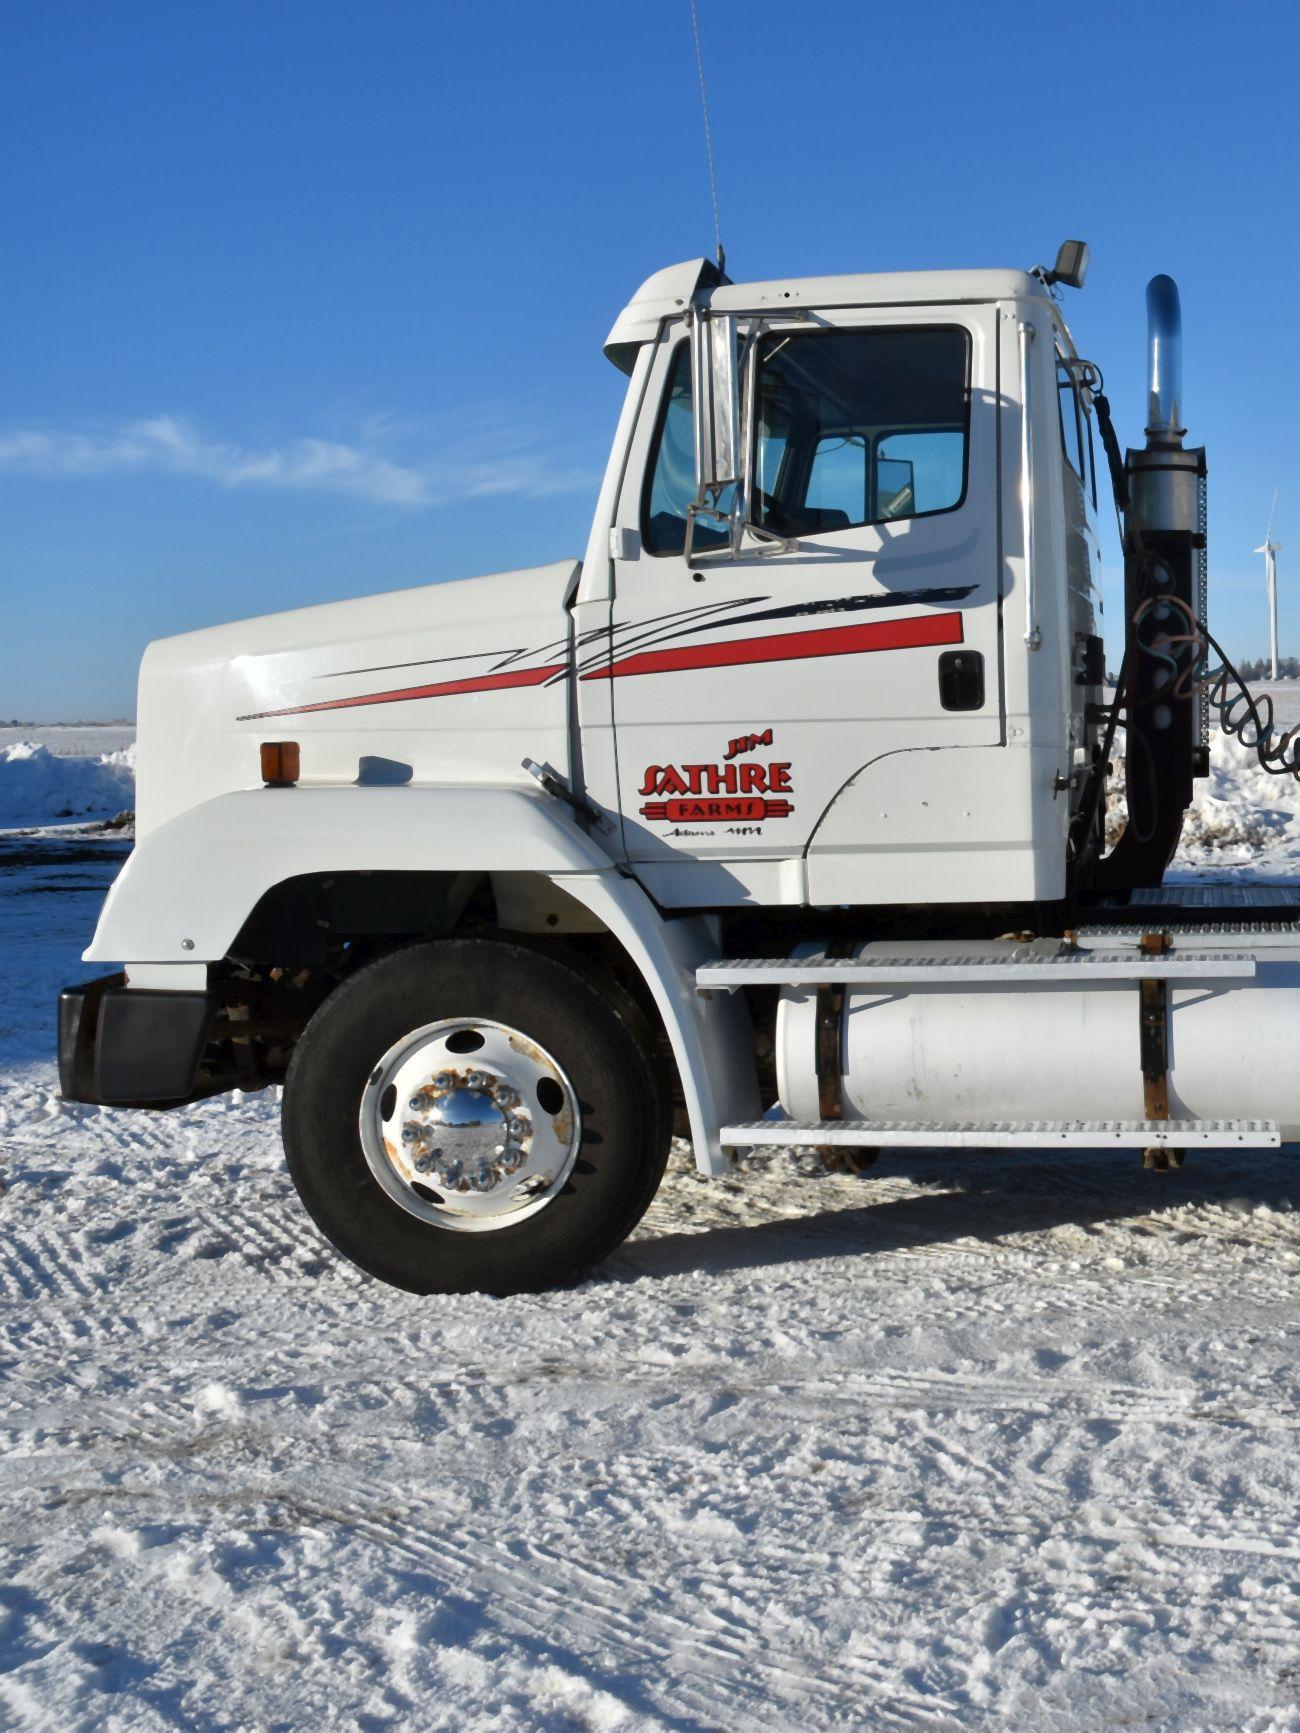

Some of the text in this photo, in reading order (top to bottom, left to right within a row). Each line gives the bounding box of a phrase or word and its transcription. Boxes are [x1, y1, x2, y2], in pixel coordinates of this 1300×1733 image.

[722, 728, 773, 760] JIM
[638, 762, 794, 796] SATHRE
[678, 803, 755, 817] FARMS
